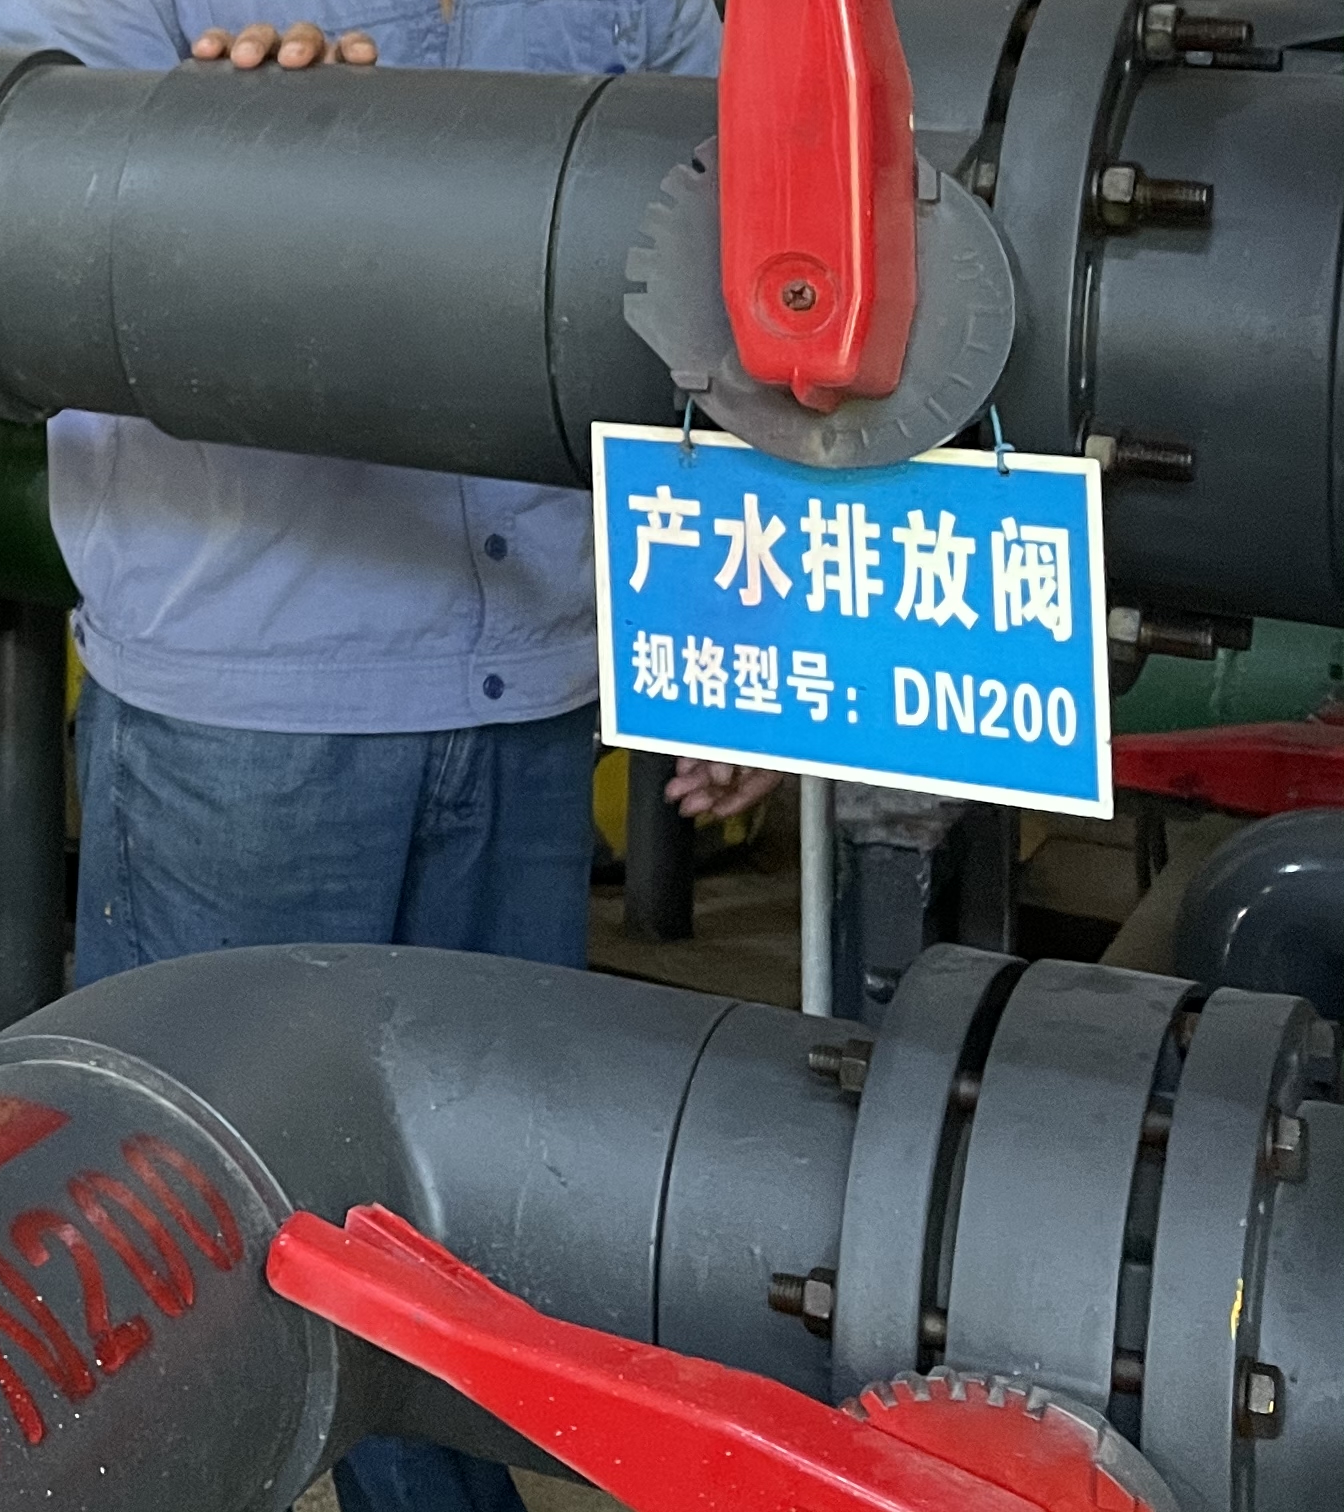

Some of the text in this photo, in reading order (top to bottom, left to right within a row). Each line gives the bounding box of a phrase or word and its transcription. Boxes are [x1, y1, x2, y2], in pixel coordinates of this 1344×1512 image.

[627, 484, 1074, 643] 产水排放阀
[893, 665, 1078, 748] DN200
